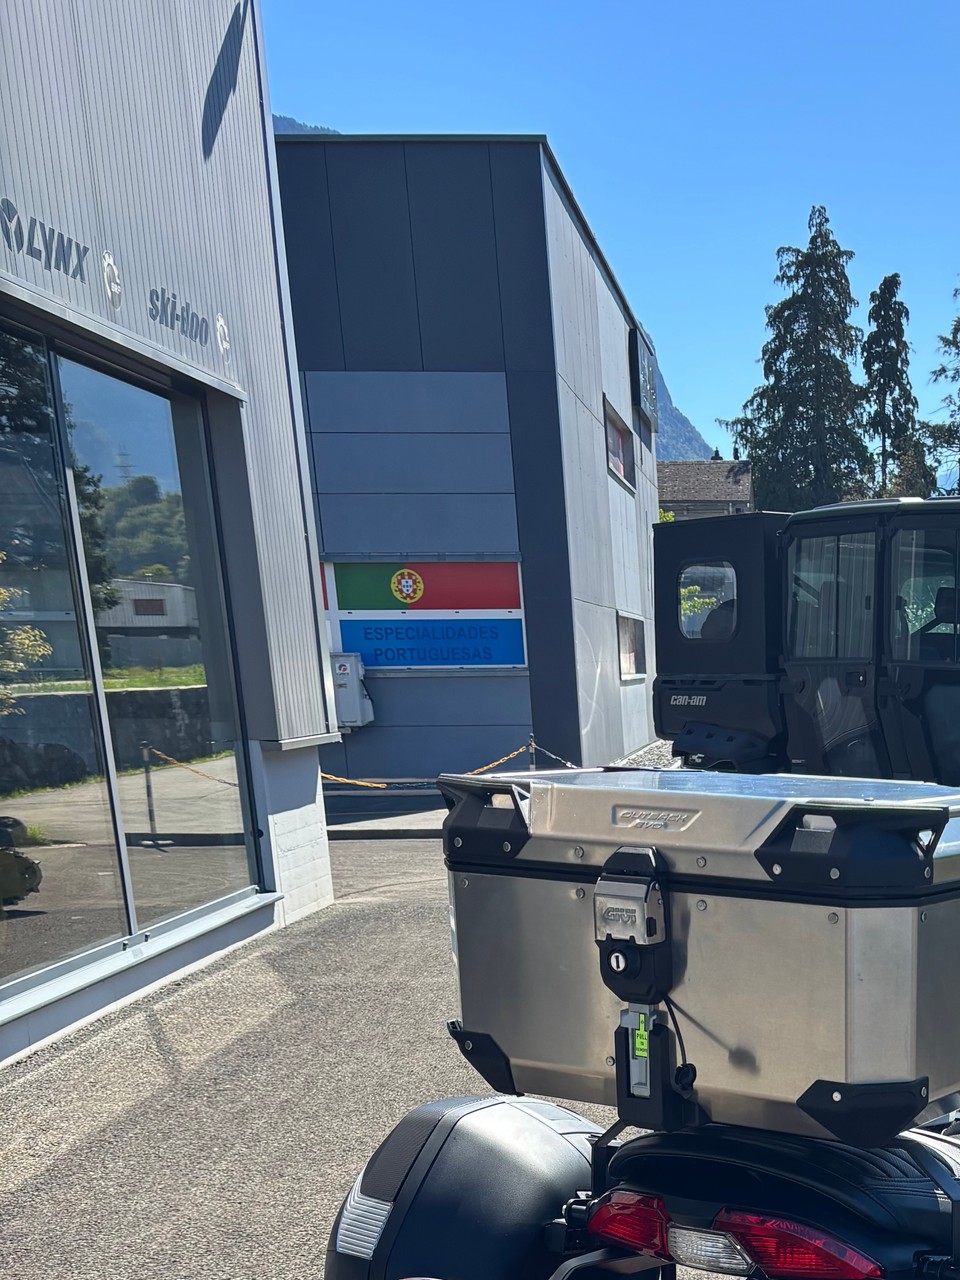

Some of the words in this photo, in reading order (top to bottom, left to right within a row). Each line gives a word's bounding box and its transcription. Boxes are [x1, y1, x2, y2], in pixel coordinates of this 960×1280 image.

[26, 216, 90, 285] LYNX
[363, 626, 499, 641] ESPECIALIDADES
[374, 647, 493, 661] PORTUGUESAS
[670, 695, 707, 706] can-am
[619, 810, 689, 823] OUTBACK
